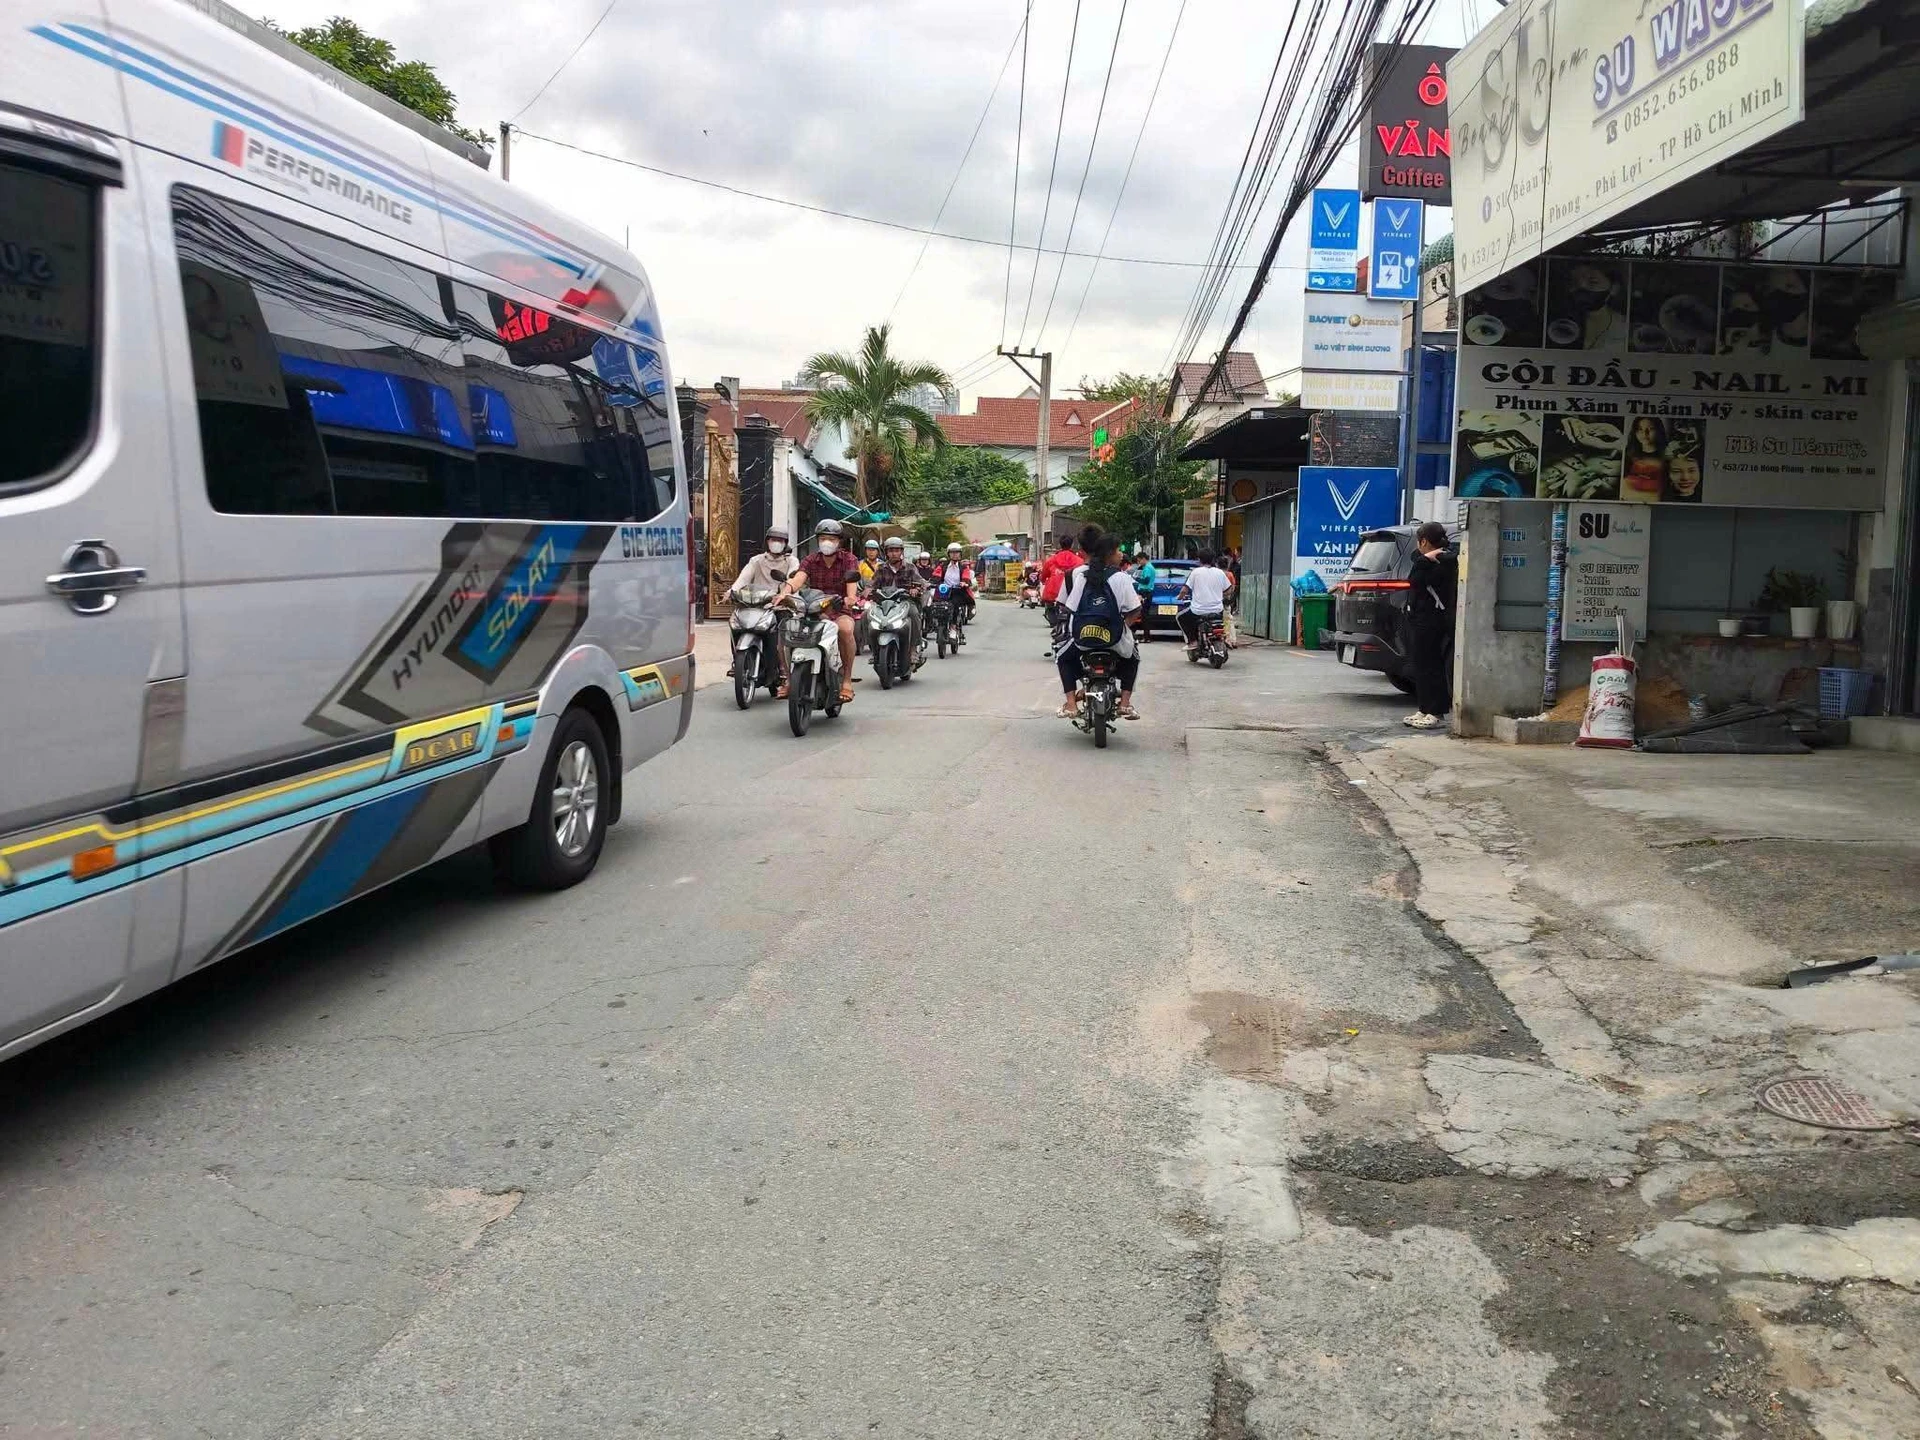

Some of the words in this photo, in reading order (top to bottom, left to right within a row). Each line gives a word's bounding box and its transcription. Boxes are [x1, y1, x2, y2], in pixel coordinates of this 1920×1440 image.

[1594, 35, 1635, 110] SU
[1624, 43, 1739, 133] 0852.656.888
[1376, 119, 1452, 157] VĂN
[1549, 195, 1581, 224] Phong
[1595, 170, 1616, 199] Phú
[1622, 156, 1642, 183] Lợi
[1659, 136, 1677, 162] TP
[1683, 123, 1702, 149] Hồ
[1708, 103, 1733, 135] Chí
[1740, 77, 1782, 118] Minh
[247, 137, 413, 225] PERFORMANCE
[1383, 165, 1444, 187] Coffee
[1382, 231, 1412, 239] VINFAST
[1482, 358, 1555, 390] GỘI
[1567, 358, 1658, 388] ĐẦU
[1692, 371, 1790, 394] NAIL
[1822, 375, 1868, 396] MI
[1495, 395, 1557, 411] Phun
[1565, 397, 1618, 413] Xăm
[1627, 397, 1692, 416] Thẩm
[1700, 402, 1733, 420] Mỹ
[1754, 404, 1804, 421] skin
[1810, 407, 1858, 421] care
[1762, 437, 1789, 455] Su
[1579, 513, 1610, 538] SU
[620, 526, 644, 559] 61E
[1314, 541, 1342, 554] VĂN
[1579, 563, 1594, 574] SU
[1596, 563, 1640, 575] BEAUTY
[1584, 575, 1610, 586] NAIL
[487, 536, 556, 653] SOLATI
[1584, 587, 1614, 596] PHUN
[1584, 597, 1605, 606] SPA
[392, 563, 482, 691] HYUNDAI
[408, 730, 475, 765] DCAR
